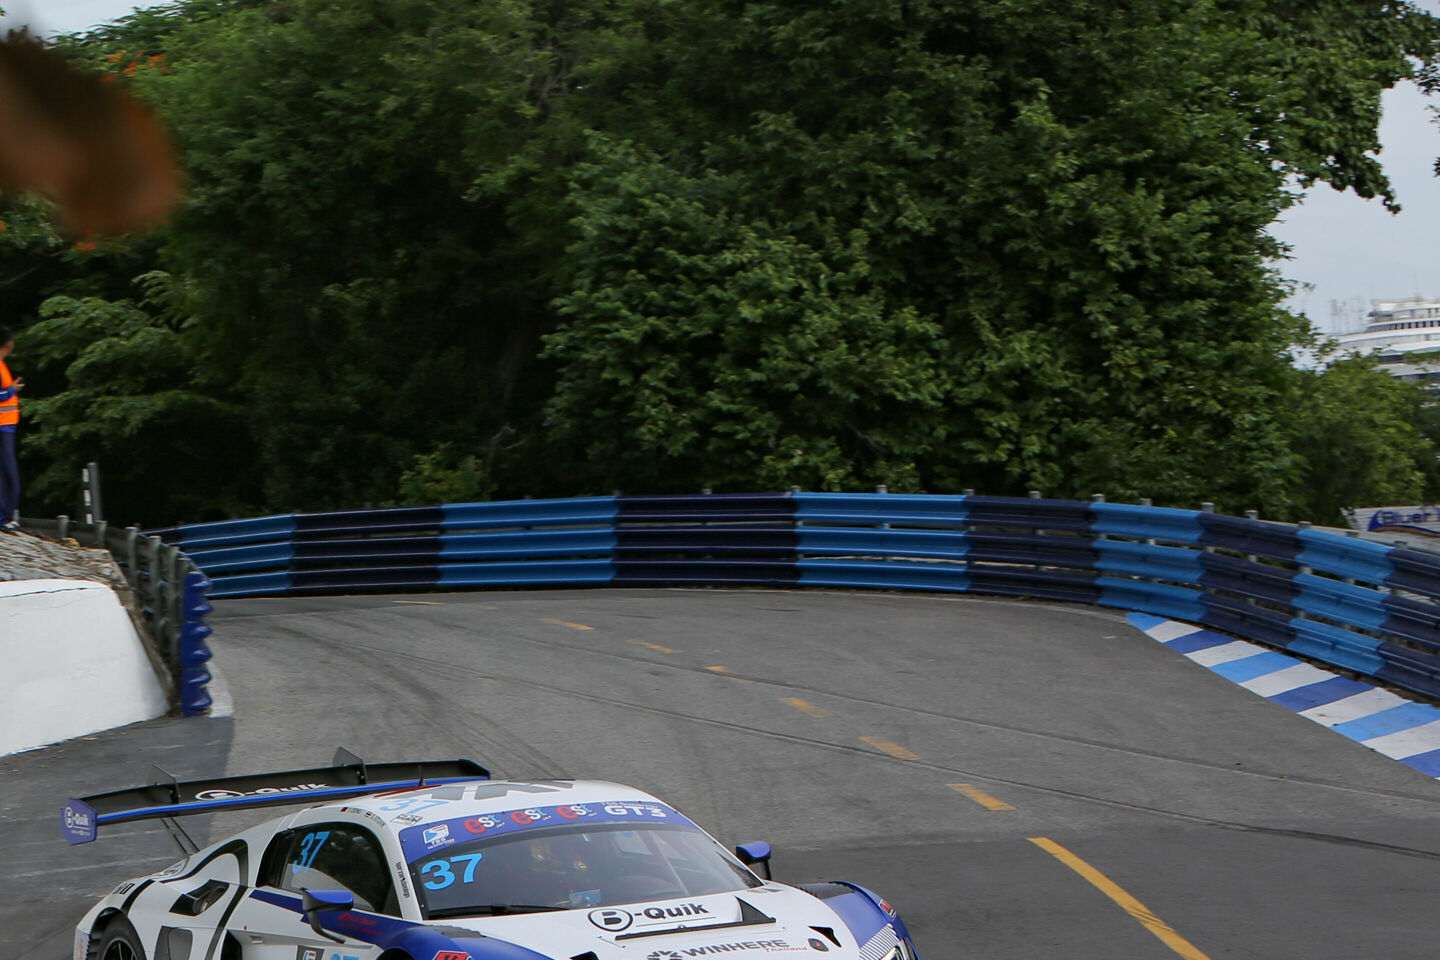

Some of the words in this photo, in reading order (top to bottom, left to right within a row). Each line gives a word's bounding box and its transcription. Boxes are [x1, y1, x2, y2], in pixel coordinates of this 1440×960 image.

[464, 814, 501, 834] est
[510, 807, 547, 825] est
[557, 804, 593, 819] est
[604, 805, 667, 818] GT3
[292, 832, 330, 874] 37
[421, 853, 483, 890] 37
[681, 940, 790, 957] WINHERE
